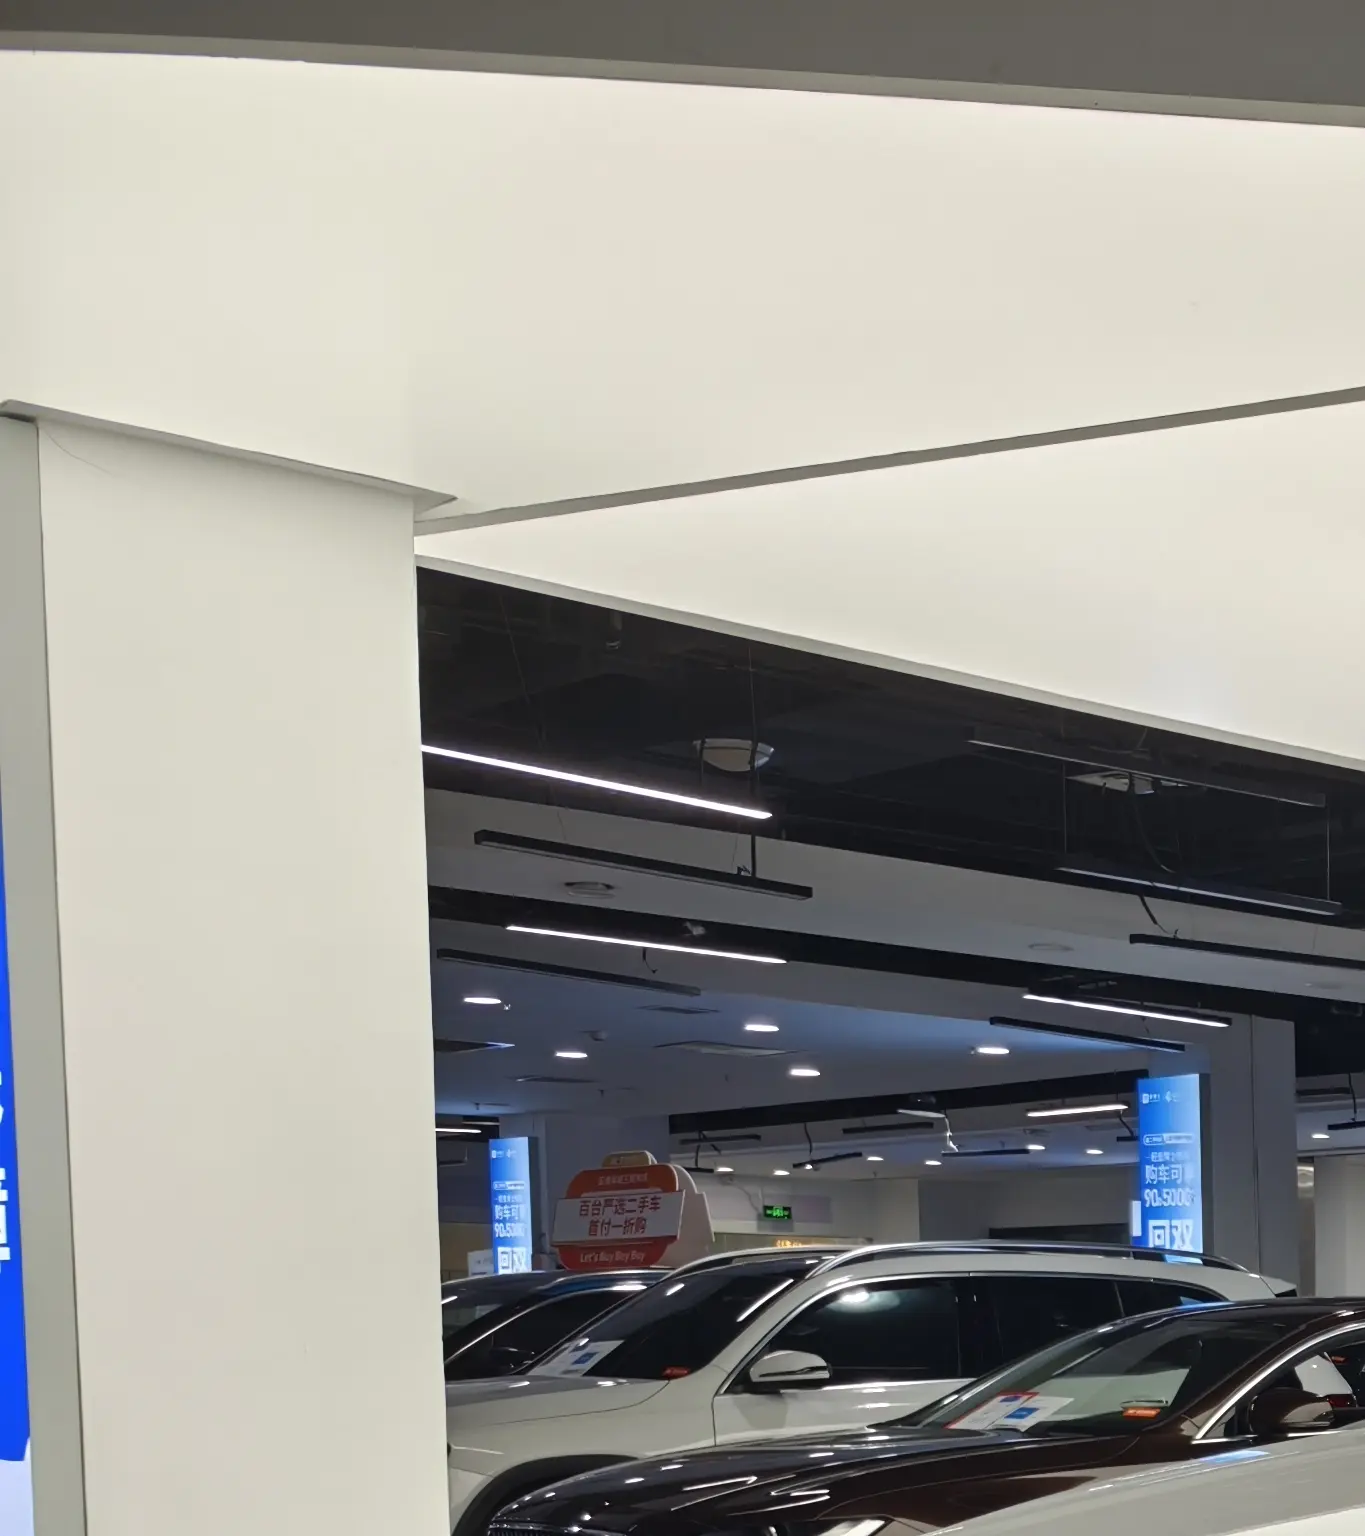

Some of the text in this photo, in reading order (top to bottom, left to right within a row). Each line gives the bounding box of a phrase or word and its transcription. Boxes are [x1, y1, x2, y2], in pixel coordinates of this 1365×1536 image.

[579, 1194, 661, 1217] 百台严选二手车
[588, 1217, 647, 1237] 首付一折购
